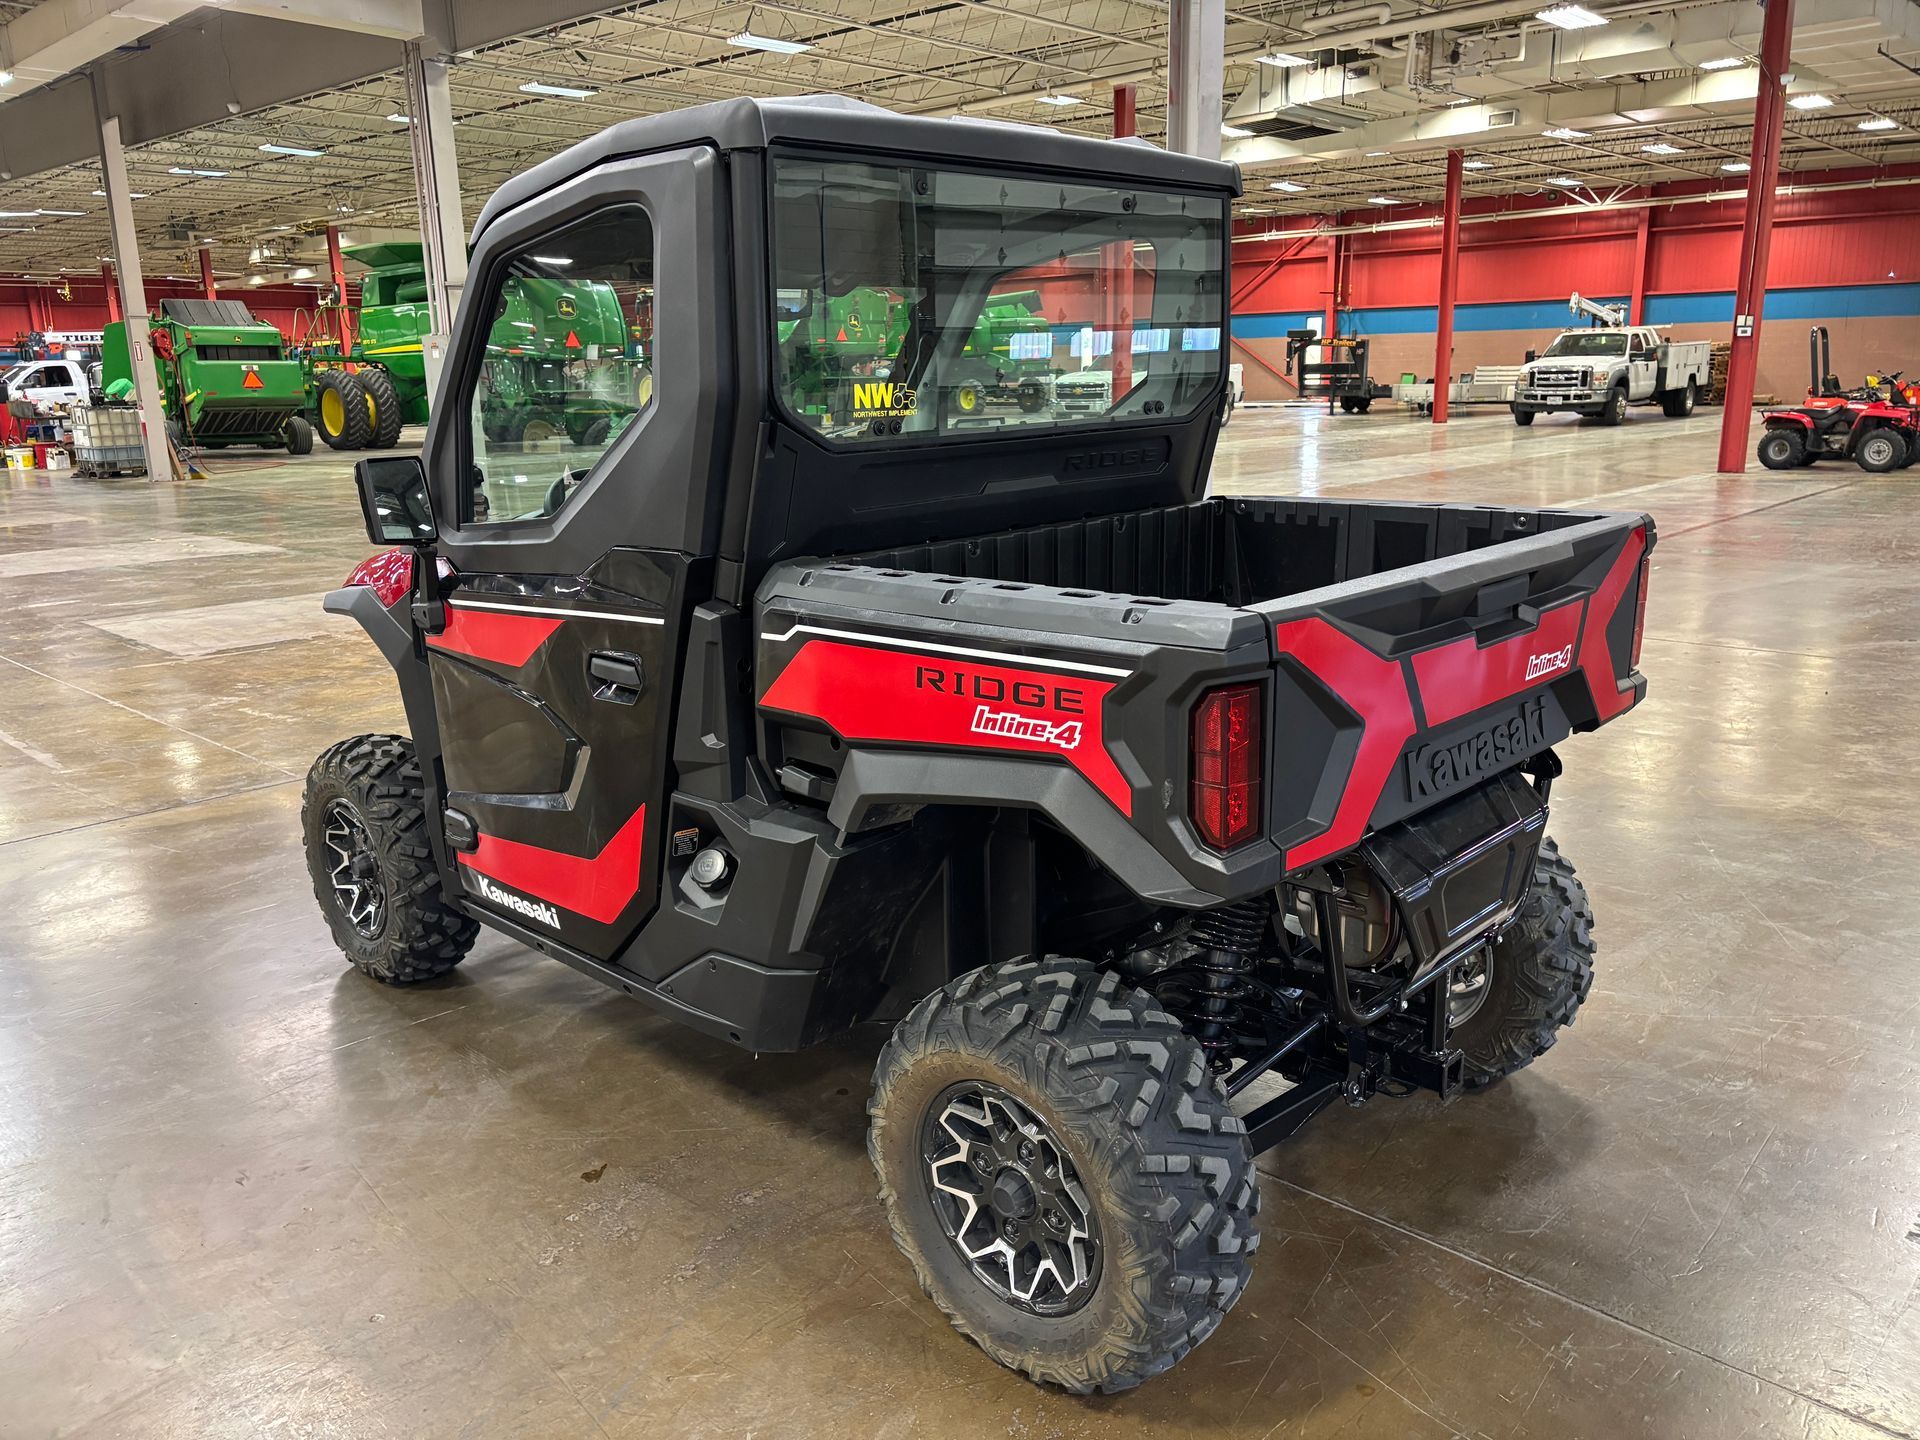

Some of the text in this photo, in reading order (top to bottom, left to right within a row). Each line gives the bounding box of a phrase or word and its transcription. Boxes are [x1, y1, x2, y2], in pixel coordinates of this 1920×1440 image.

[853, 383, 894, 409] NW
[853, 408, 918, 418] NORTHWEST IMPLEMENT
[1062, 446, 1161, 472] RIDGE
[1524, 644, 1572, 682] Inline-4
[916, 666, 1084, 714] RIDGE
[970, 705, 1083, 750] Inline-4
[1403, 694, 1548, 803] Kawasaki
[478, 874, 561, 930] Kawasaki
